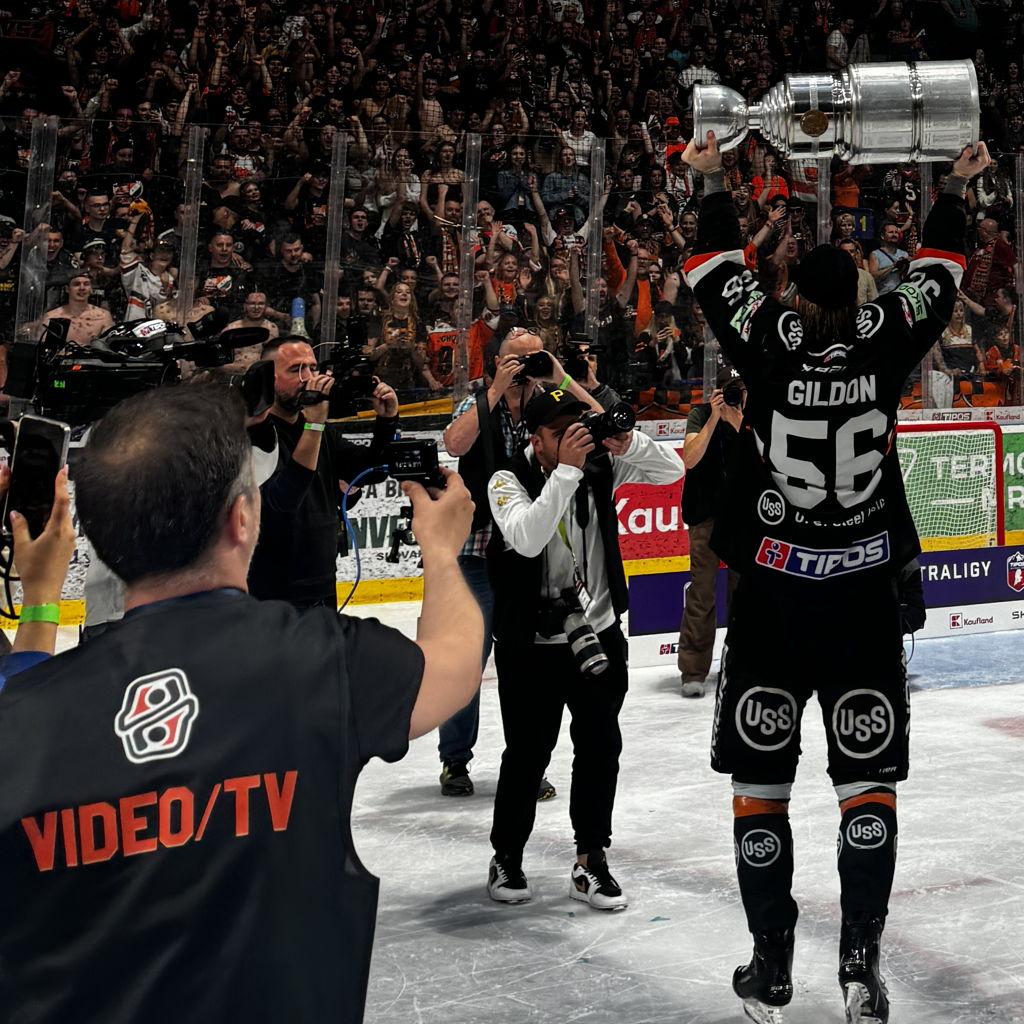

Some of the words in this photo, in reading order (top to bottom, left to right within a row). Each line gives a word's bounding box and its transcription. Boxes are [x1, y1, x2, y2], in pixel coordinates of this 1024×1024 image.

[550, 389, 564, 402] P
[787, 374, 877, 407] GILDON
[942, 413, 971, 421] TIPOS
[996, 413, 1021, 421] Kaufland
[768, 407, 888, 510] 56
[614, 496, 689, 536] Kau
[762, 495, 782, 517] USS
[796, 537, 885, 576] TIPOS
[920, 560, 992, 583] TRALIGY
[963, 616, 994, 626] Kaufland
[745, 699, 793, 736] USS
[840, 705, 887, 742] USS
[20, 769, 299, 873] VIDEO/TV
[851, 821, 883, 841] USS
[744, 836, 776, 859] USS
